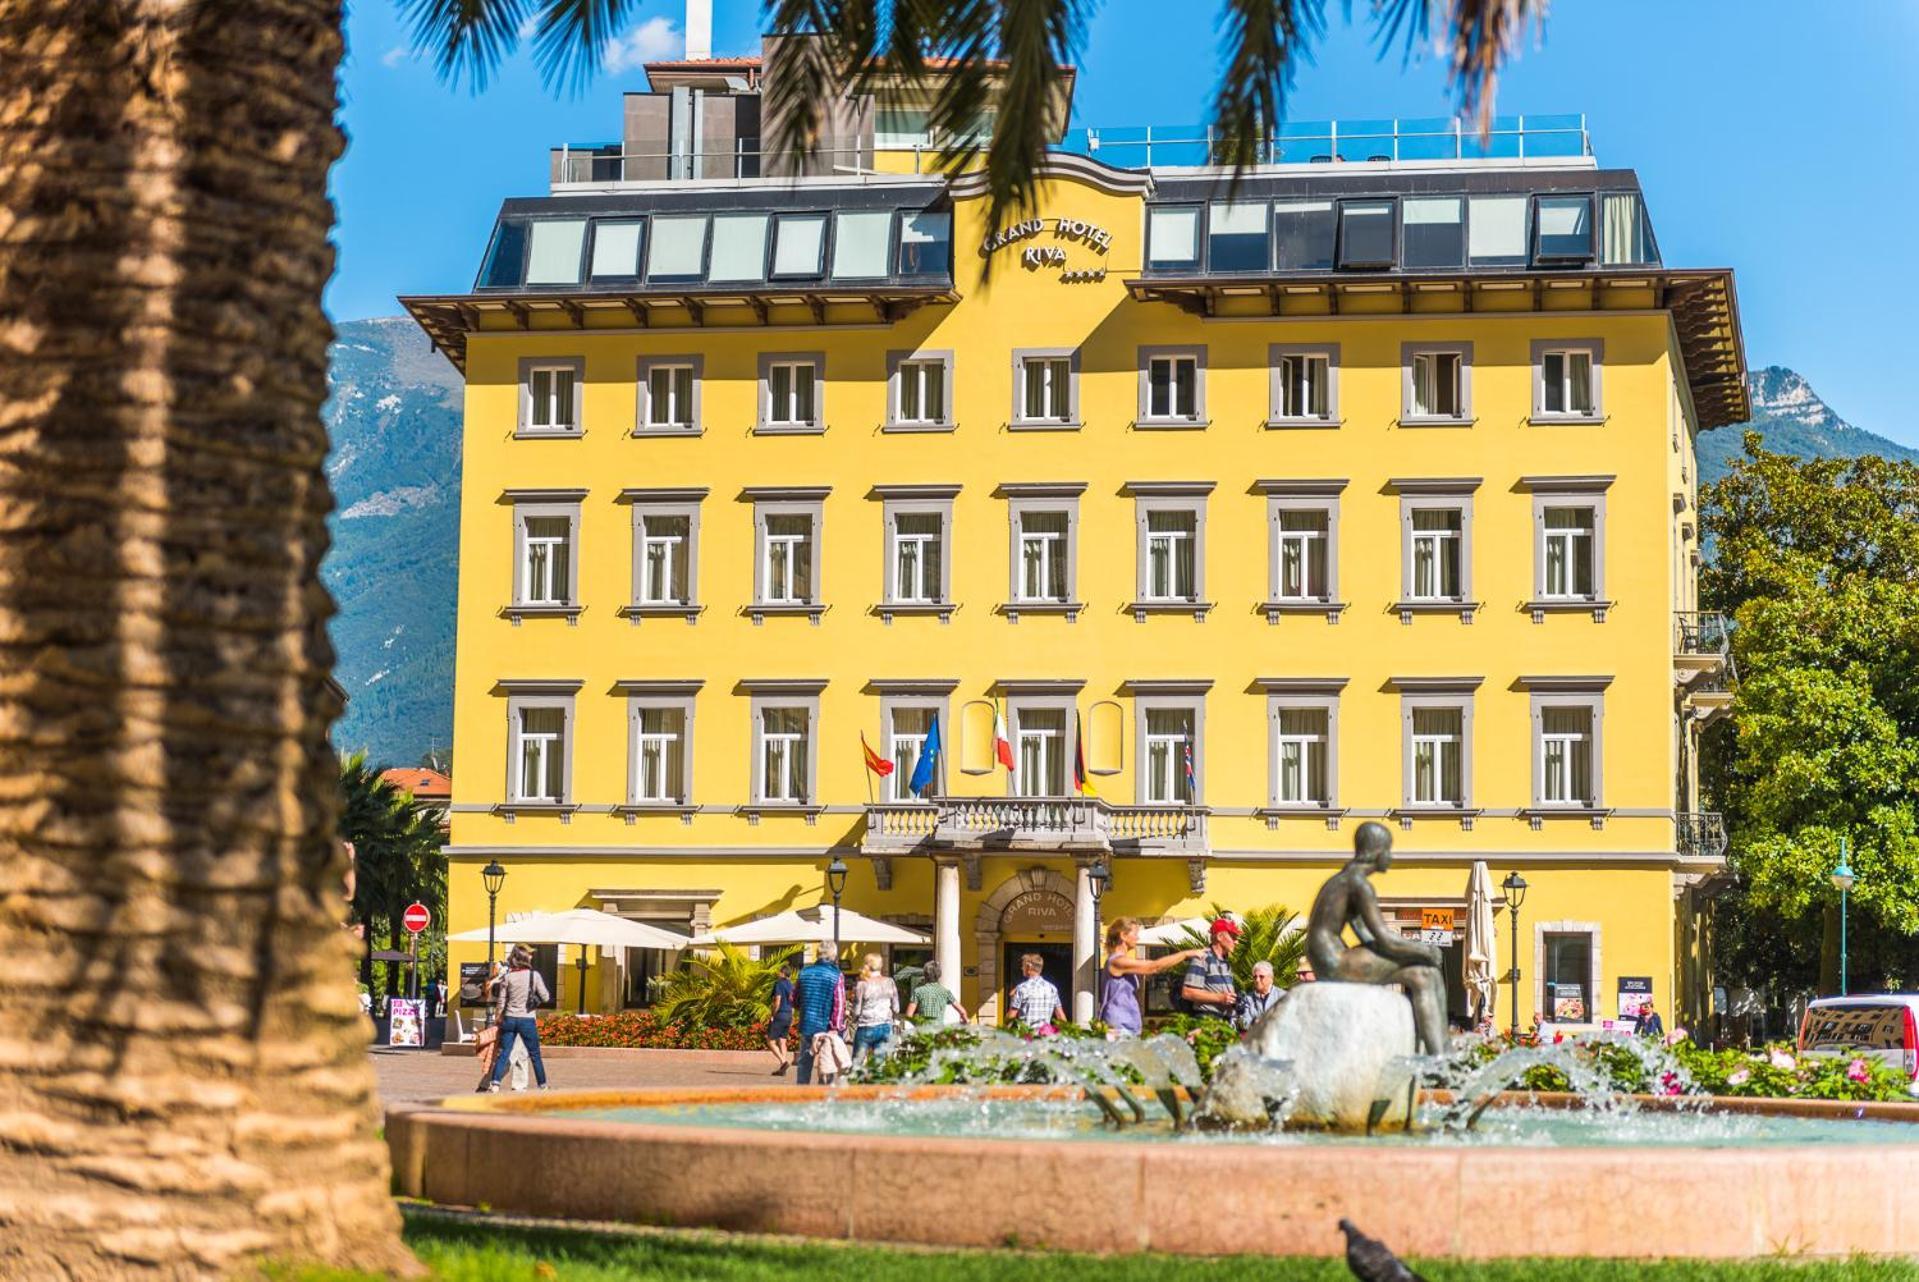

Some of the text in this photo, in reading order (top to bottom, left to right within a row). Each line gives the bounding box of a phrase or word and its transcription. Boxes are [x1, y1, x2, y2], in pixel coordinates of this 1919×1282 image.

[983, 218, 1113, 252] GRAND HOTEL
[1026, 247, 1066, 264] RIVA
[1003, 892, 1042, 924] GRAND
[1027, 907, 1056, 917] RIVA
[1423, 913, 1453, 925] TAXI
